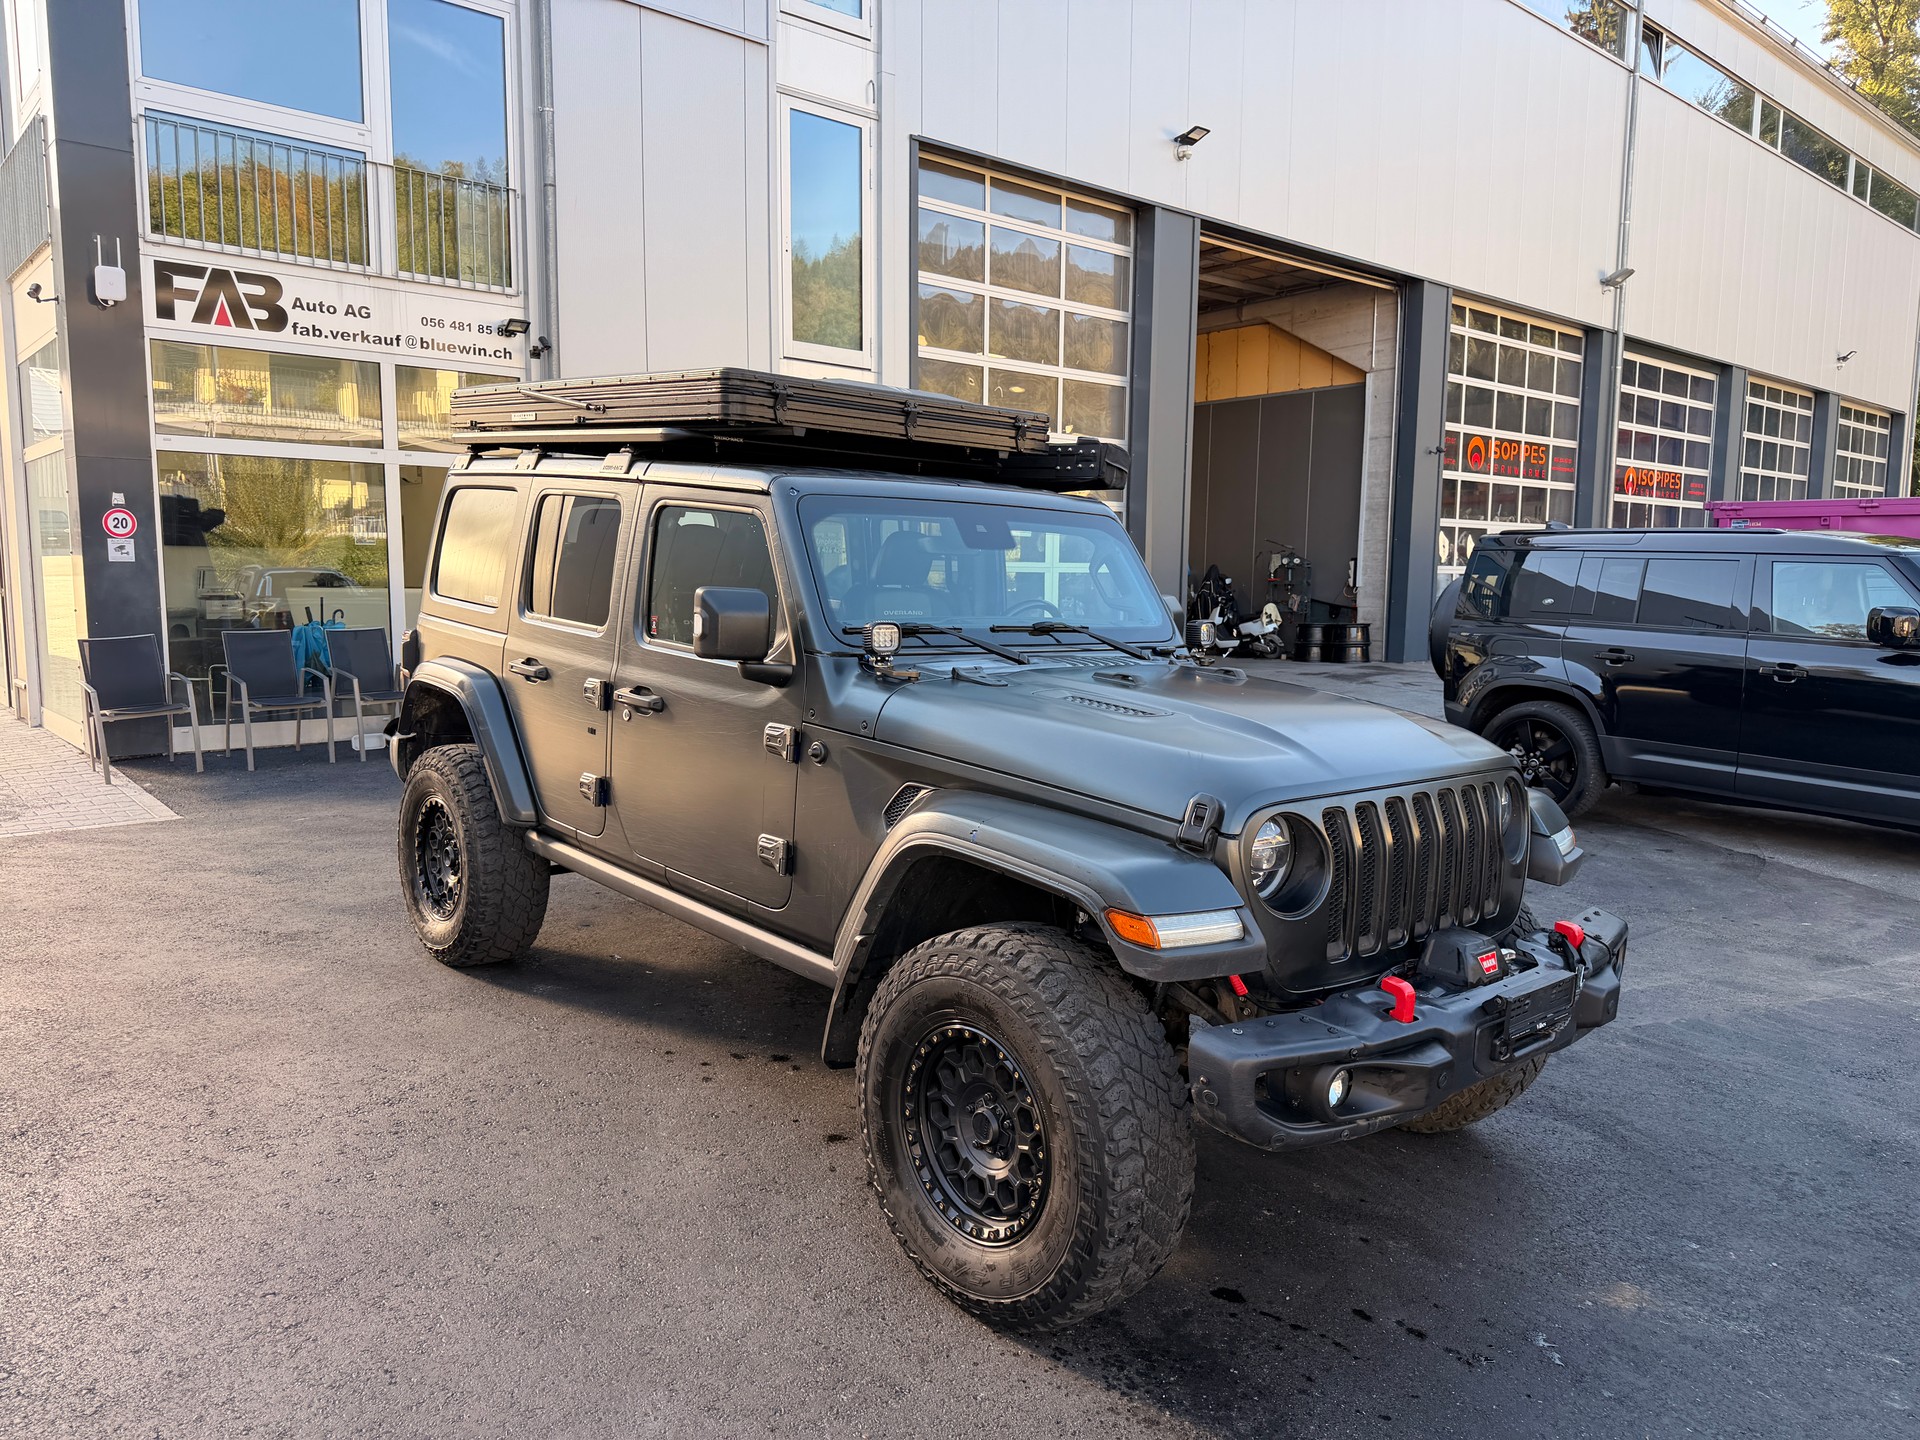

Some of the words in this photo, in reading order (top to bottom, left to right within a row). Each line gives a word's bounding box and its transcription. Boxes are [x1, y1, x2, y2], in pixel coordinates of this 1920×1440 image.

[154, 260, 289, 333] FAB
[291, 297, 338, 315] Auto
[344, 304, 371, 319] AG
[421, 316, 445, 329] 056
[449, 320, 472, 332] 481
[477, 324, 493, 335] 85
[1488, 439, 1547, 465] ISOPIPES
[1638, 468, 1681, 489] ISOPIPES
[112, 517, 128, 529] 20
